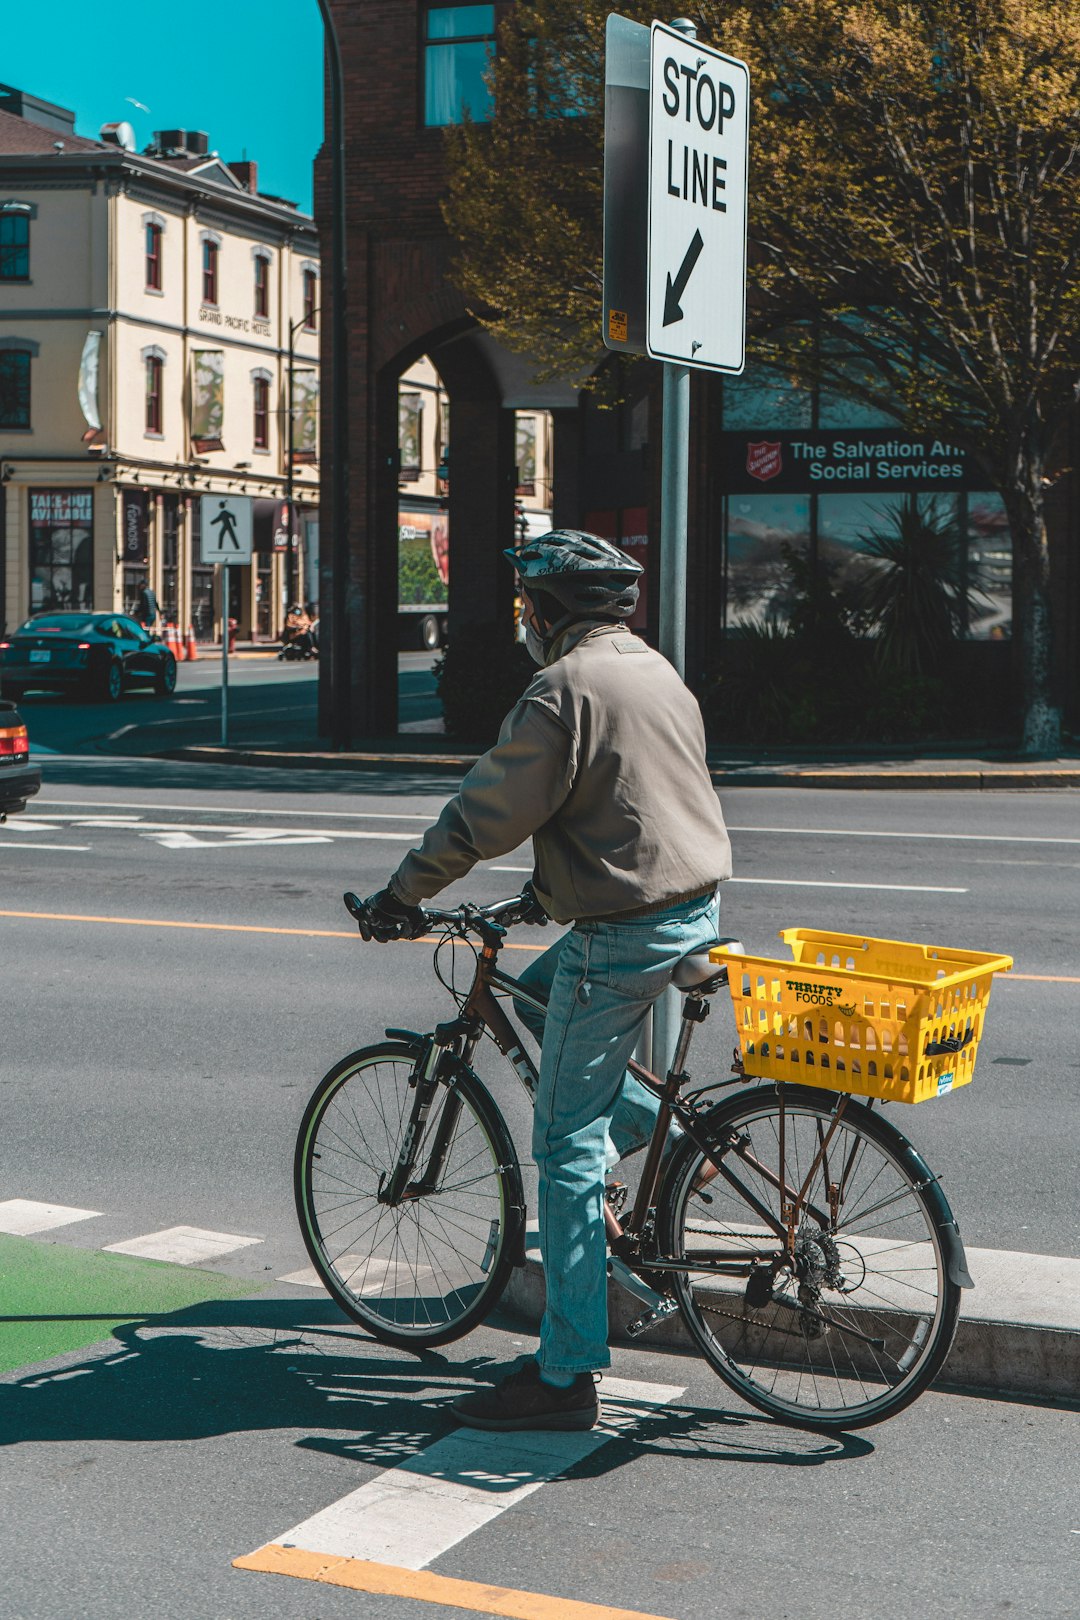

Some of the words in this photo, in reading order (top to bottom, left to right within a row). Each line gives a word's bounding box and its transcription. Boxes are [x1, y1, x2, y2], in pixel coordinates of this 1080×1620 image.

[663, 57, 735, 135] STOP
[668, 139, 727, 213] LINE
[199, 308, 222, 326] GRAND
[225, 315, 249, 333] PACIFIC
[252, 322, 272, 337] HOTEL
[790, 442, 826, 459] The
[833, 440, 924, 458] Salvation
[810, 461, 870, 479] Social
[877, 461, 963, 478] Services
[31, 495, 92, 508] TAKE-OUT
[31, 508, 92, 520] AVAILABLE
[786, 981, 842, 997] THRIFTY
[796, 992, 833, 1007] FOODS
